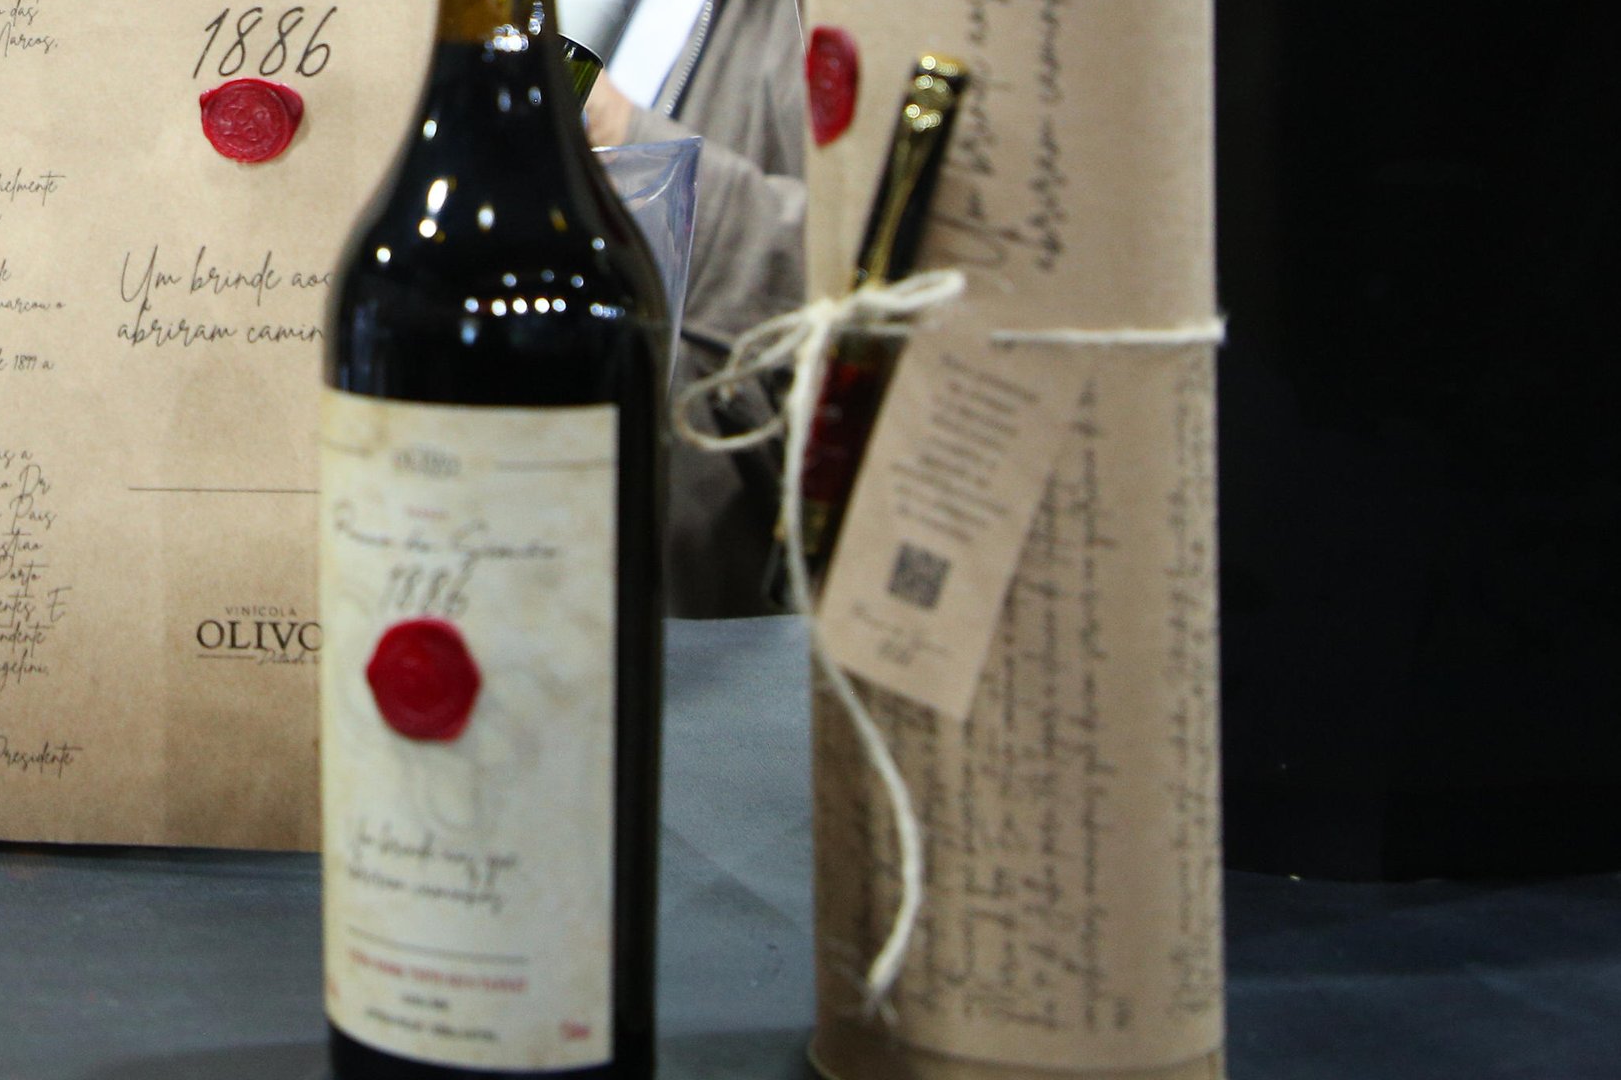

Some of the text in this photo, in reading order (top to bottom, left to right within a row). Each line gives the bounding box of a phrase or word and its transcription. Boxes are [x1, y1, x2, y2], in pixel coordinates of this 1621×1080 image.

[193, 6, 337, 78] 1886
[121, 245, 182, 302] Um
[191, 246, 281, 306] brinde
[117, 306, 325, 348] abriram camin
[225, 606, 297, 617] VINÍCOLA
